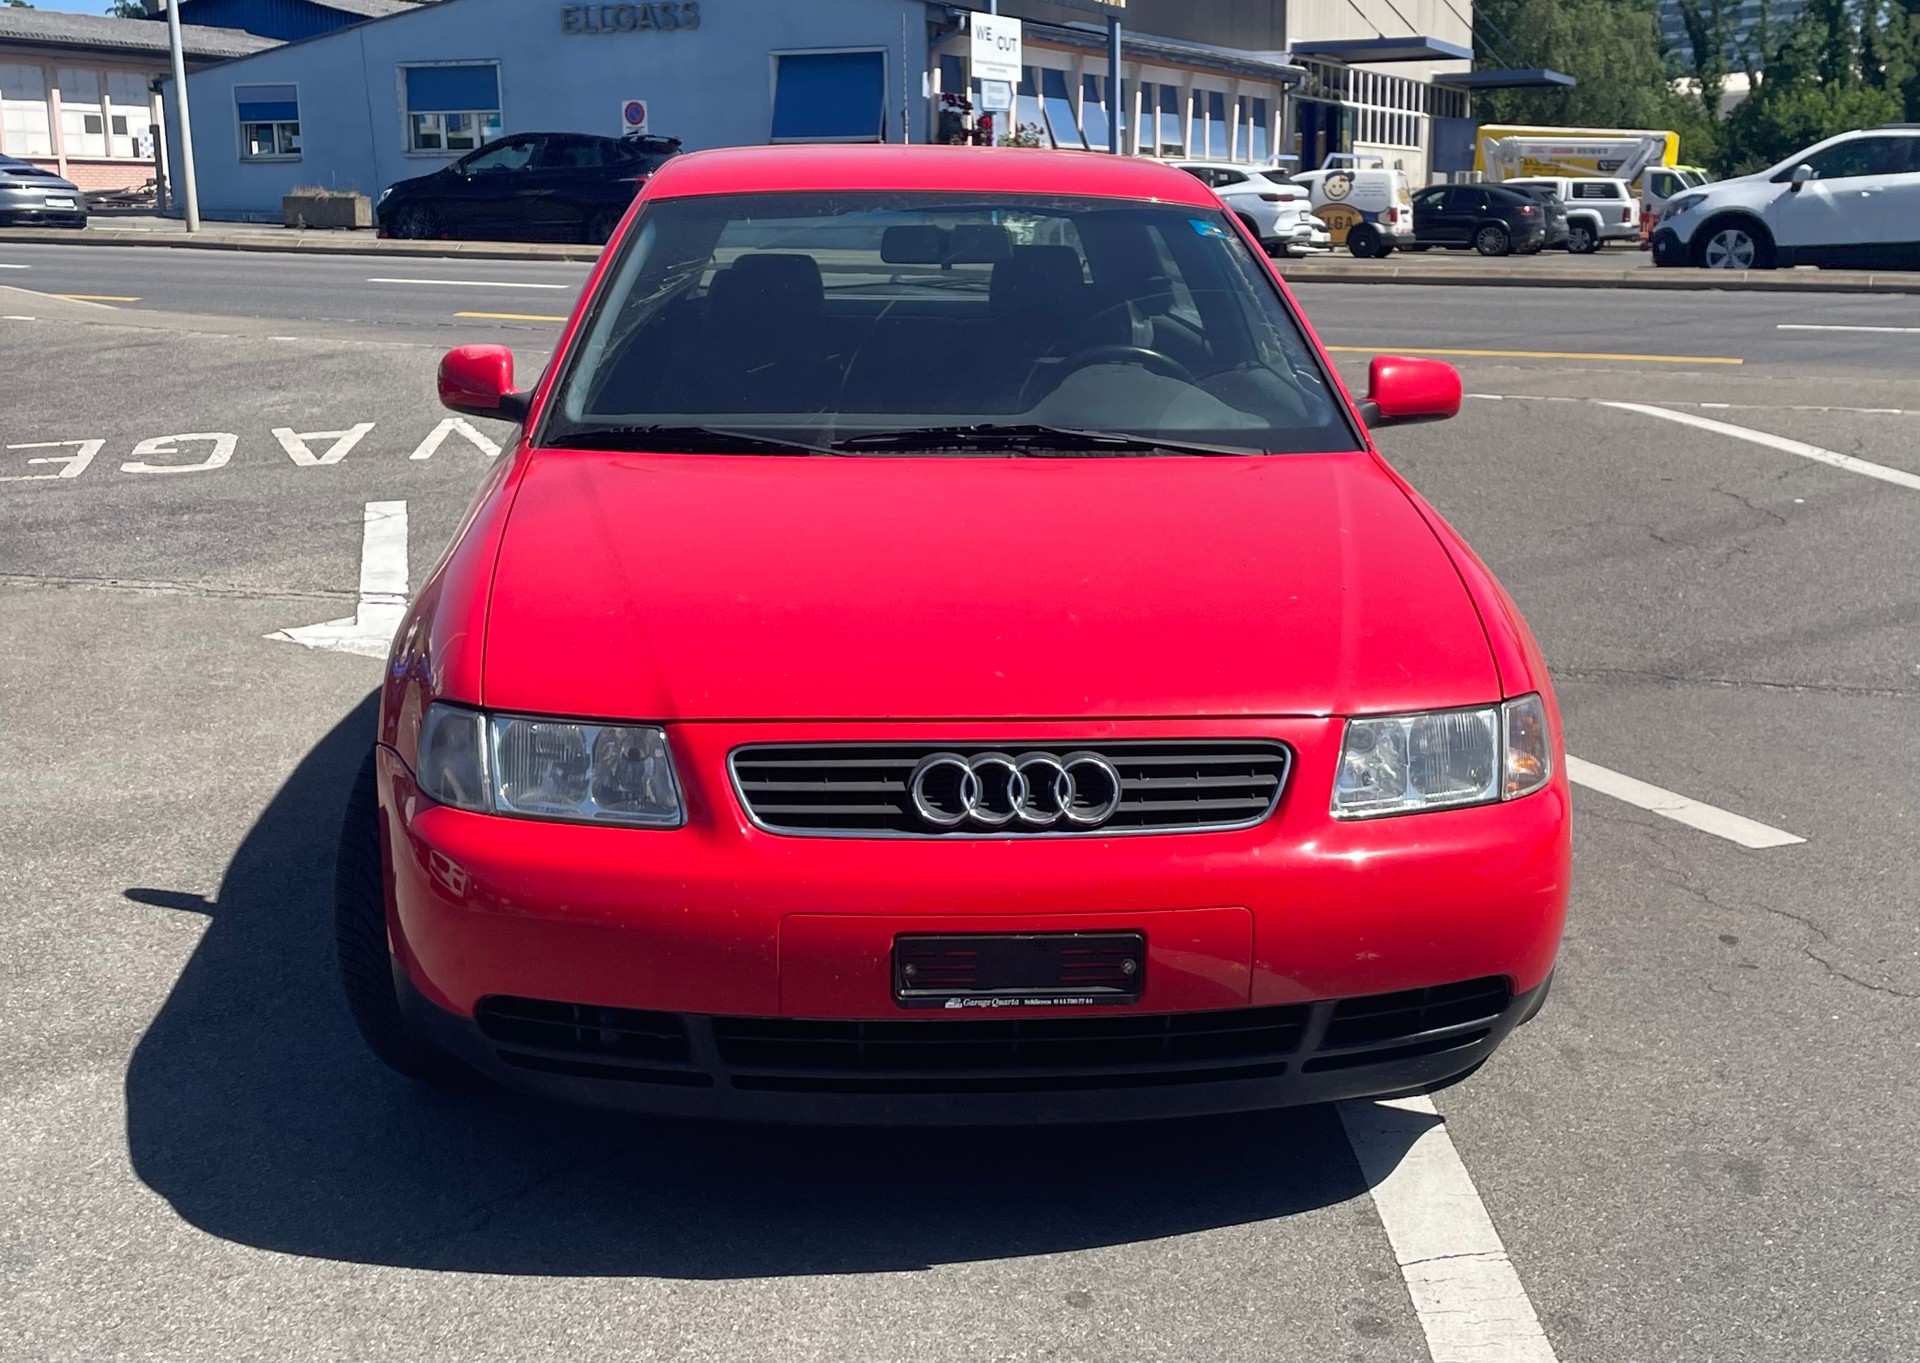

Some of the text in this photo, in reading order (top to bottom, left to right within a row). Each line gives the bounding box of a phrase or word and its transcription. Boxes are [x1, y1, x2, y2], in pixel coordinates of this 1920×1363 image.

[561, 1, 701, 35] ELLGASS
[975, 25, 992, 42] WE
[997, 36, 1018, 52] CUT
